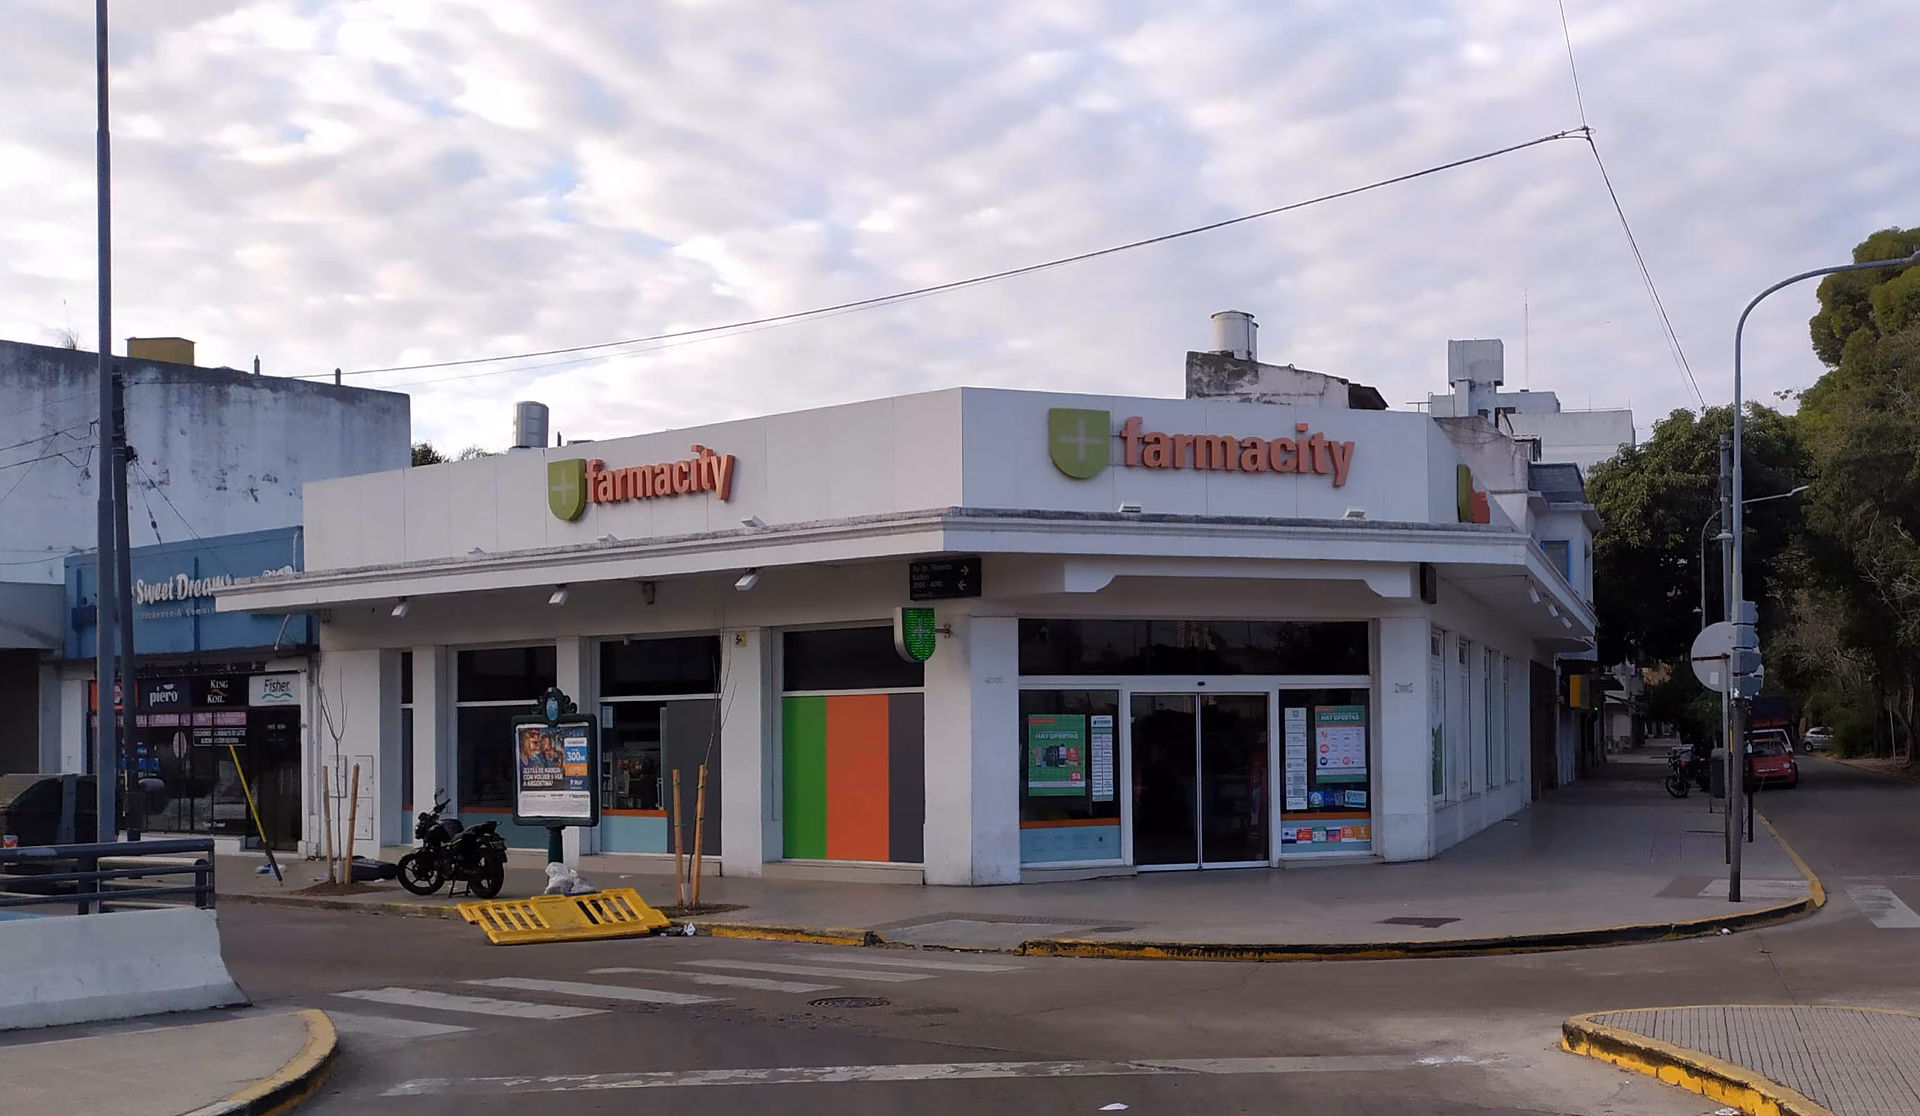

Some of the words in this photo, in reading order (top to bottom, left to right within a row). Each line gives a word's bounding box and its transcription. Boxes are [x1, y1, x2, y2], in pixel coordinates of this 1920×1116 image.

[1119, 415, 1355, 488] farmacity
[585, 443, 736, 505] farmacity
[136, 575, 174, 605] Sweet
[149, 684, 179, 707] piero
[210, 679, 229, 689] KING
